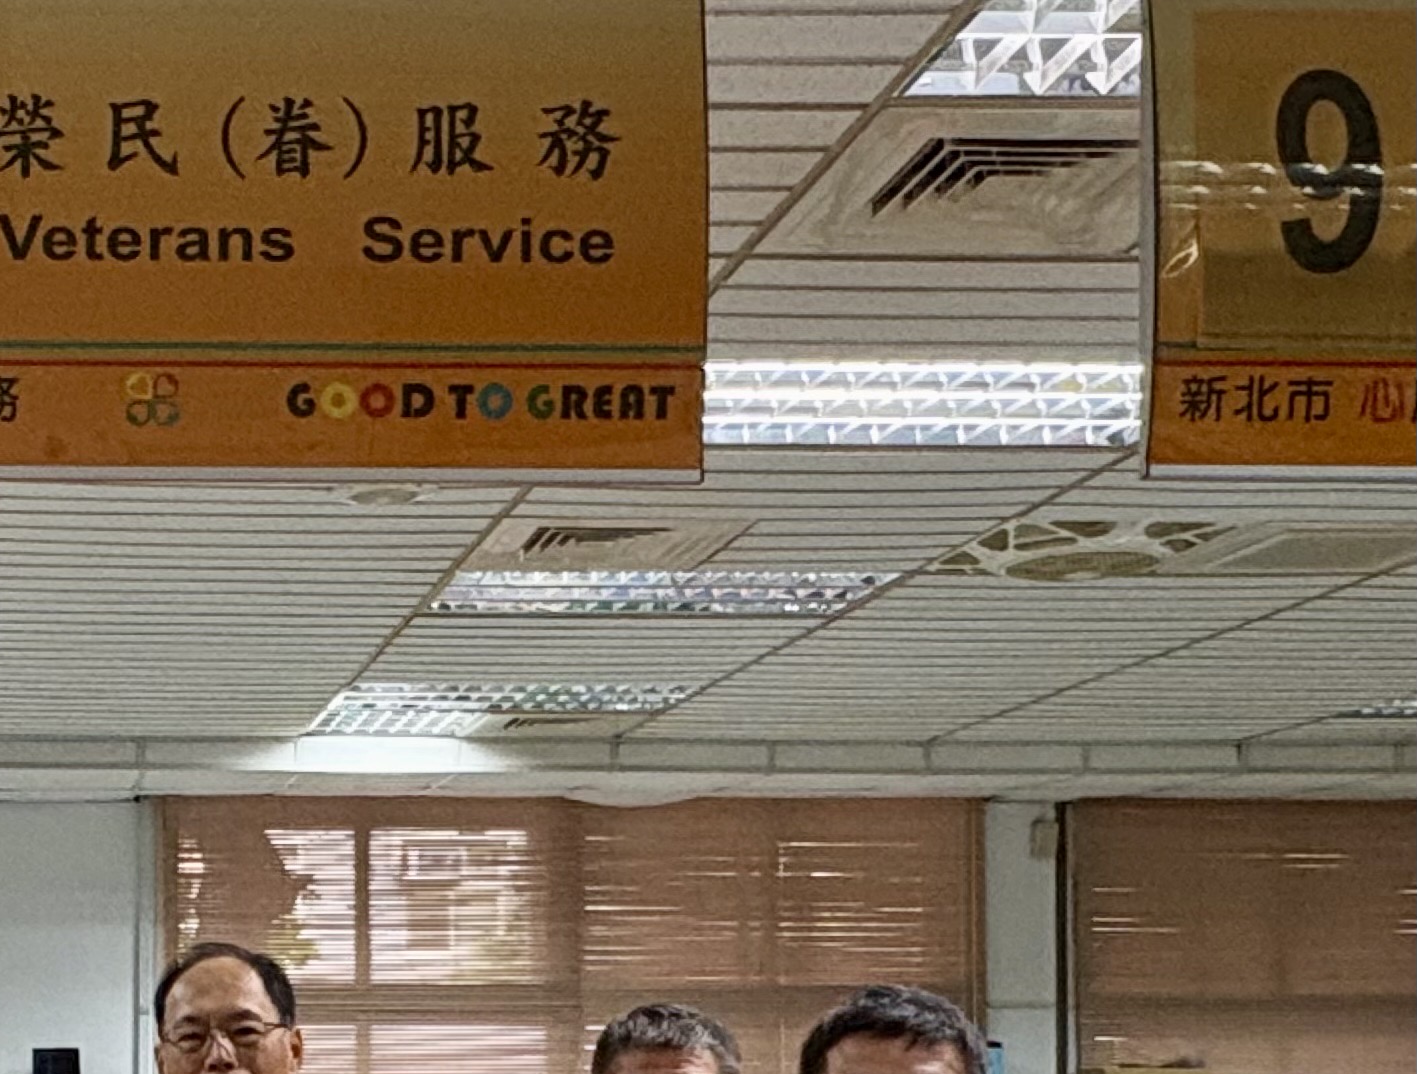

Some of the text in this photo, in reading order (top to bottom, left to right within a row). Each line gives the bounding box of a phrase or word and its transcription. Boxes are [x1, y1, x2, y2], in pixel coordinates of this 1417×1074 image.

[1276, 69, 1383, 273] 9
[361, 216, 615, 264] Service
[286, 381, 675, 420] GOOD TO GREAT
[1179, 375, 1417, 424] 新北市 心
